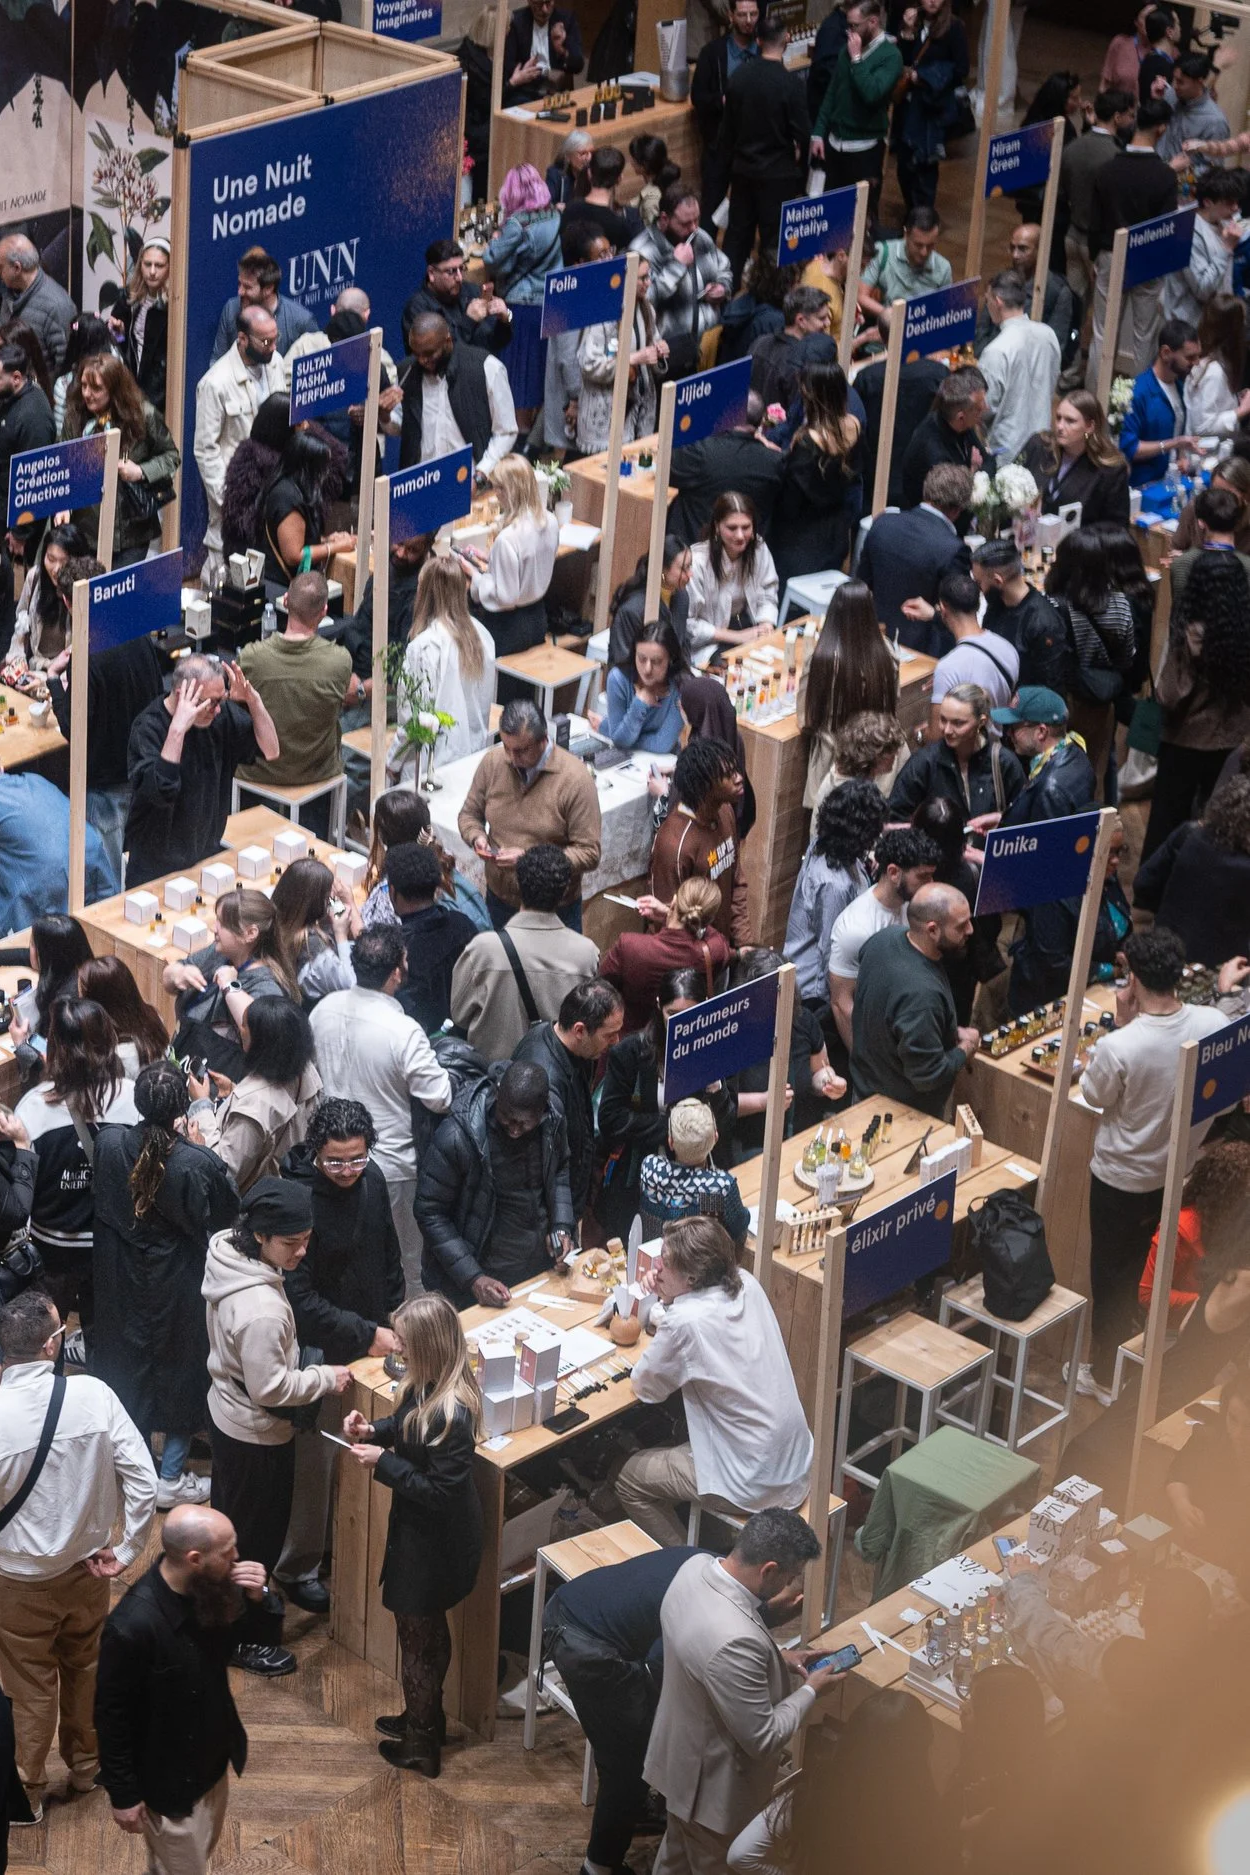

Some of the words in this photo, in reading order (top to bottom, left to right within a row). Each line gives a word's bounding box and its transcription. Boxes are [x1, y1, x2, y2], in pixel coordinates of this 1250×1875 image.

[376, 0, 417, 15] Voyages
[376, 8, 433, 31] Imaginaires
[990, 155, 1020, 174] Green
[213, 174, 258, 204] Une
[265, 153, 312, 191] Nuit
[10, 189, 47, 208] NOMADE
[212, 193, 306, 241] Nomade
[786, 203, 824, 224] Maison
[1129, 220, 1175, 248] Hellenist
[288, 237, 360, 297] UNN
[550, 275, 577, 294] Folia
[906, 307, 972, 339] Destinations
[907, 304, 926, 320] Les
[296, 353, 333, 377] SULTAN
[295, 378, 346, 408] PERFUMES
[296, 370, 327, 392] PASHA
[16, 456, 60, 477] Angelos
[15, 468, 70, 492] Créations
[393, 469, 441, 499] mmoire
[14, 484, 70, 508] Olfactives
[93, 573, 136, 604] Baruti
[992, 835, 1038, 858] Unika
[673, 997, 750, 1040] Parfumeurs
[672, 1043, 690, 1060] du
[693, 1021, 739, 1052] monde
[1201, 1036, 1234, 1065] Bleu
[851, 1220, 893, 1254] élixir
[895, 1192, 936, 1236] privé
